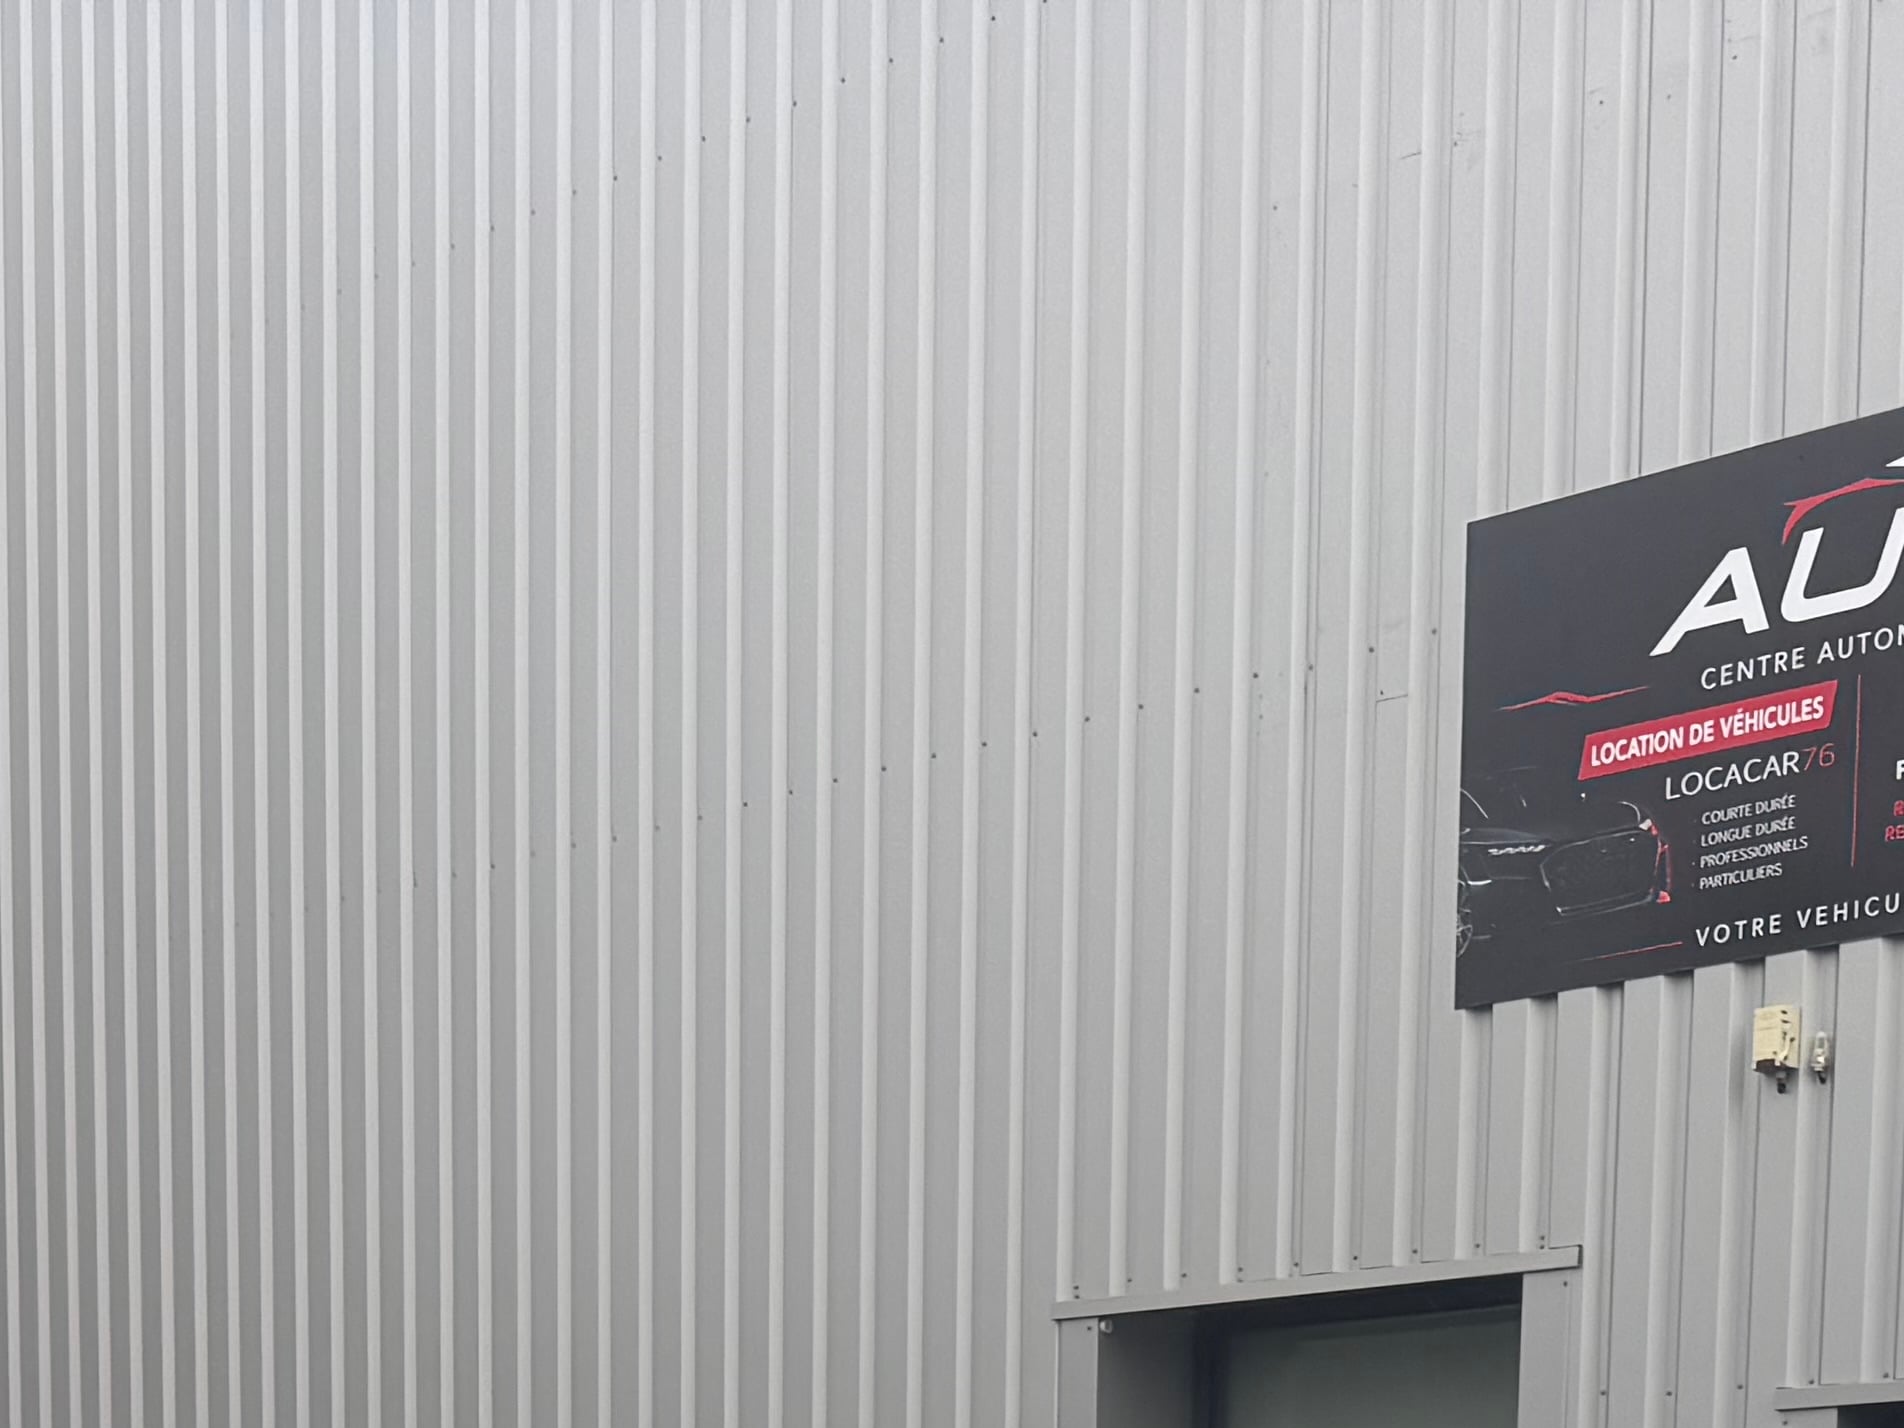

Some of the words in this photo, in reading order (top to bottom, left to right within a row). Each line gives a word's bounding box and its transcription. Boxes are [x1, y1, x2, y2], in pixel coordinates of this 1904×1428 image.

[1700, 646, 1806, 690] CENTRE
[1591, 726, 1684, 767] LOCATION
[1689, 723, 1714, 747] DE
[1721, 695, 1824, 738] VÉHICULES
[1665, 743, 1835, 800] LOCACAR76
[1701, 803, 1752, 825] COURTE
[1756, 792, 1796, 815] DURÉE
[1701, 825, 1752, 847] LONGUE
[1756, 815, 1796, 837] DURÉE
[1700, 836, 1808, 868] PROFESSIONNELS
[1699, 862, 1783, 890] PARTICULIERS
[1695, 915, 1782, 947] VOTRE
